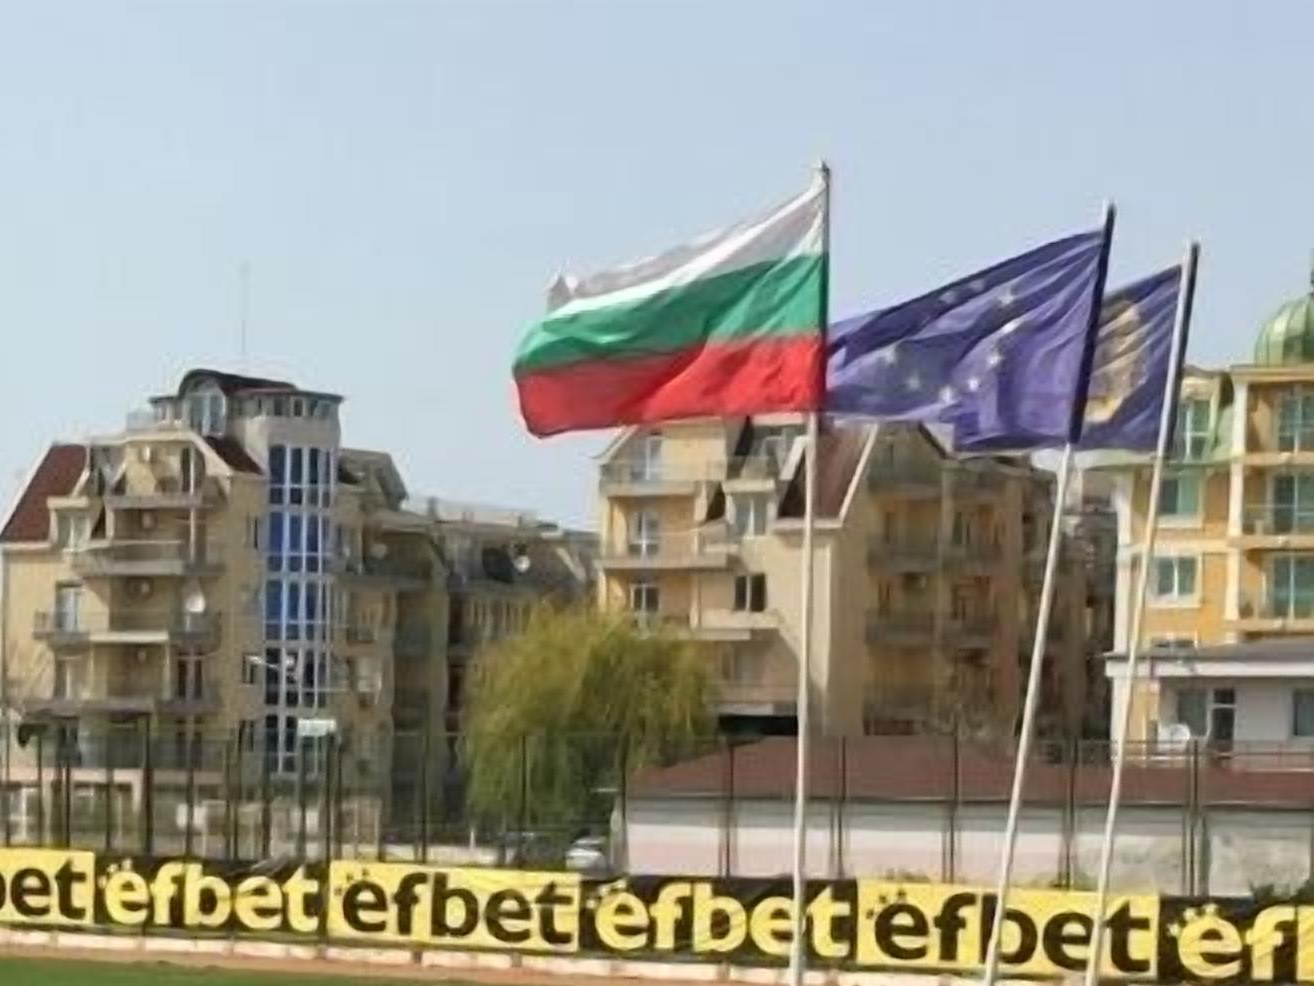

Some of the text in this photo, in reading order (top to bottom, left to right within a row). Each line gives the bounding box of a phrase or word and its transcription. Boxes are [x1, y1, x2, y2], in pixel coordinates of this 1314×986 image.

[105, 863, 320, 933] efbet
[342, 872, 574, 945] efbet
[596, 883, 852, 958] efbet
[873, 892, 1151, 973] efbet
